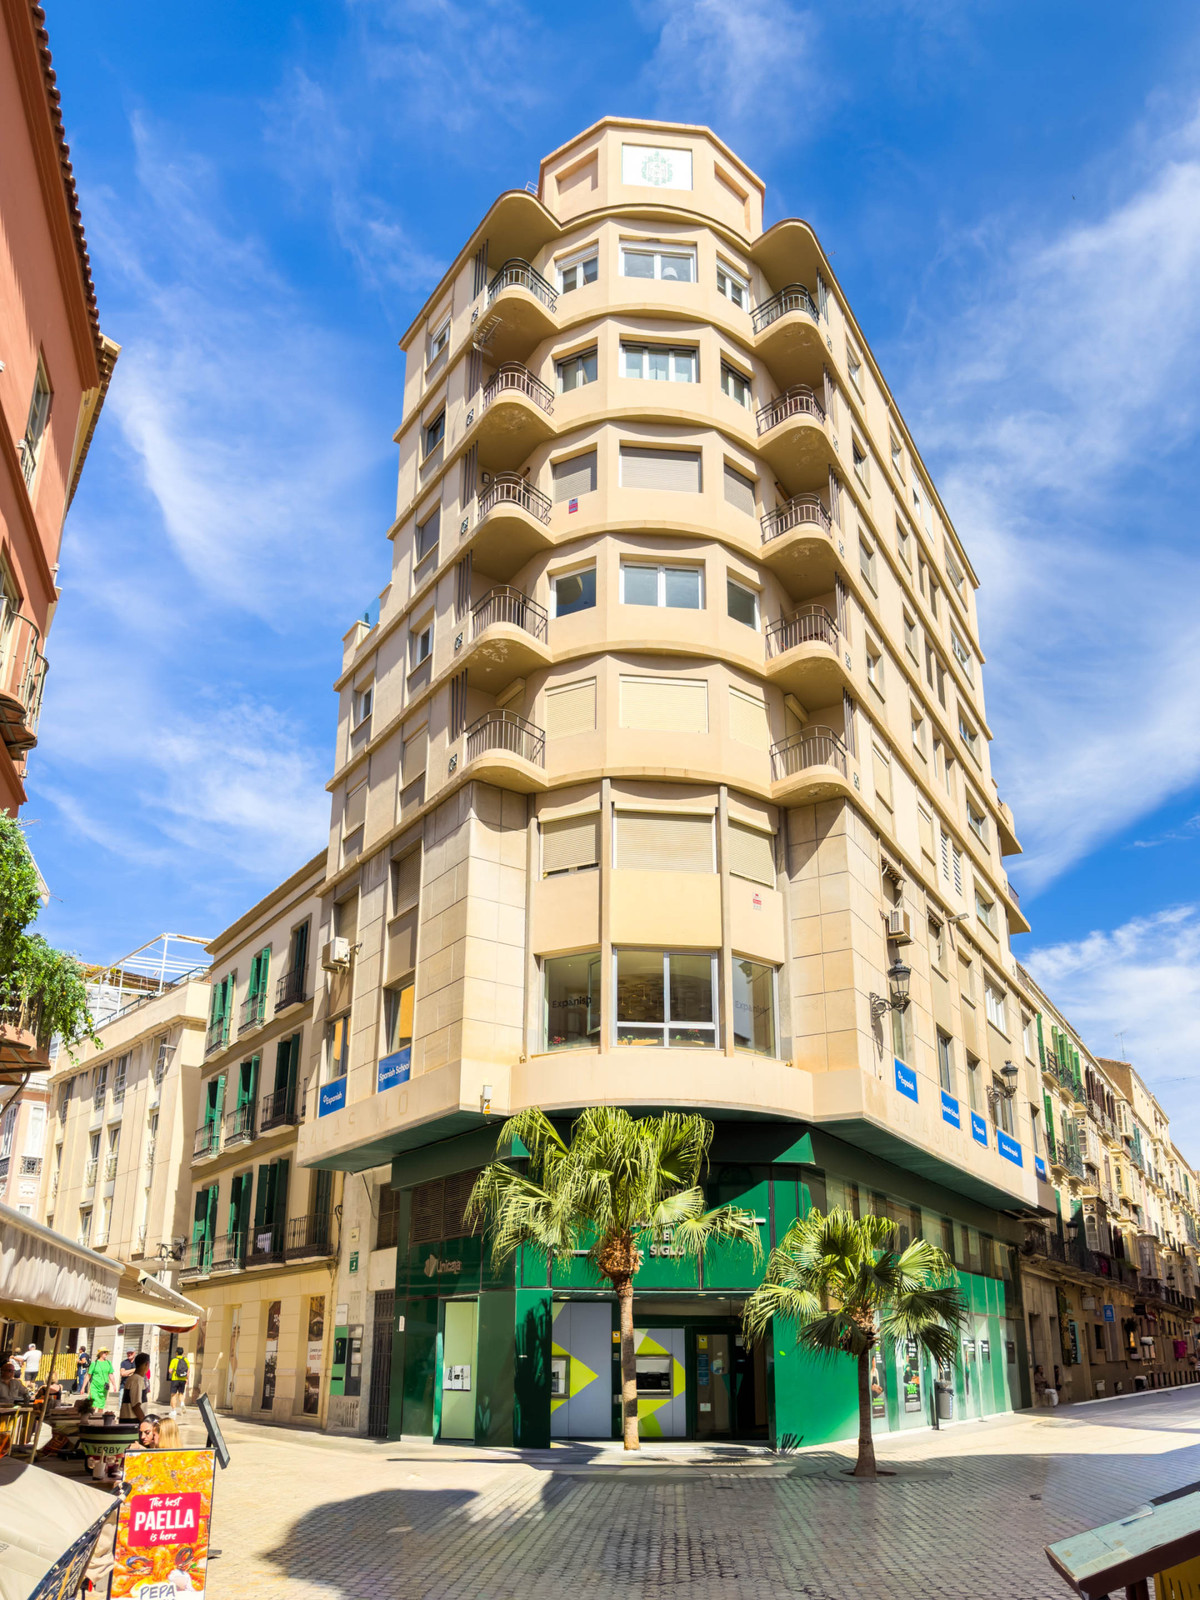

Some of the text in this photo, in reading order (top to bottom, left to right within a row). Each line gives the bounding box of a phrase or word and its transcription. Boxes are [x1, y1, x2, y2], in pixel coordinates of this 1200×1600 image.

[552, 996, 592, 1008] Expanish
[436, 1260, 462, 1275] Unicaja
[149, 1496, 183, 1510] The best
[134, 1508, 194, 1532] PAELLA
[150, 1530, 177, 1543] is here
[140, 1584, 176, 1600] PEPA
